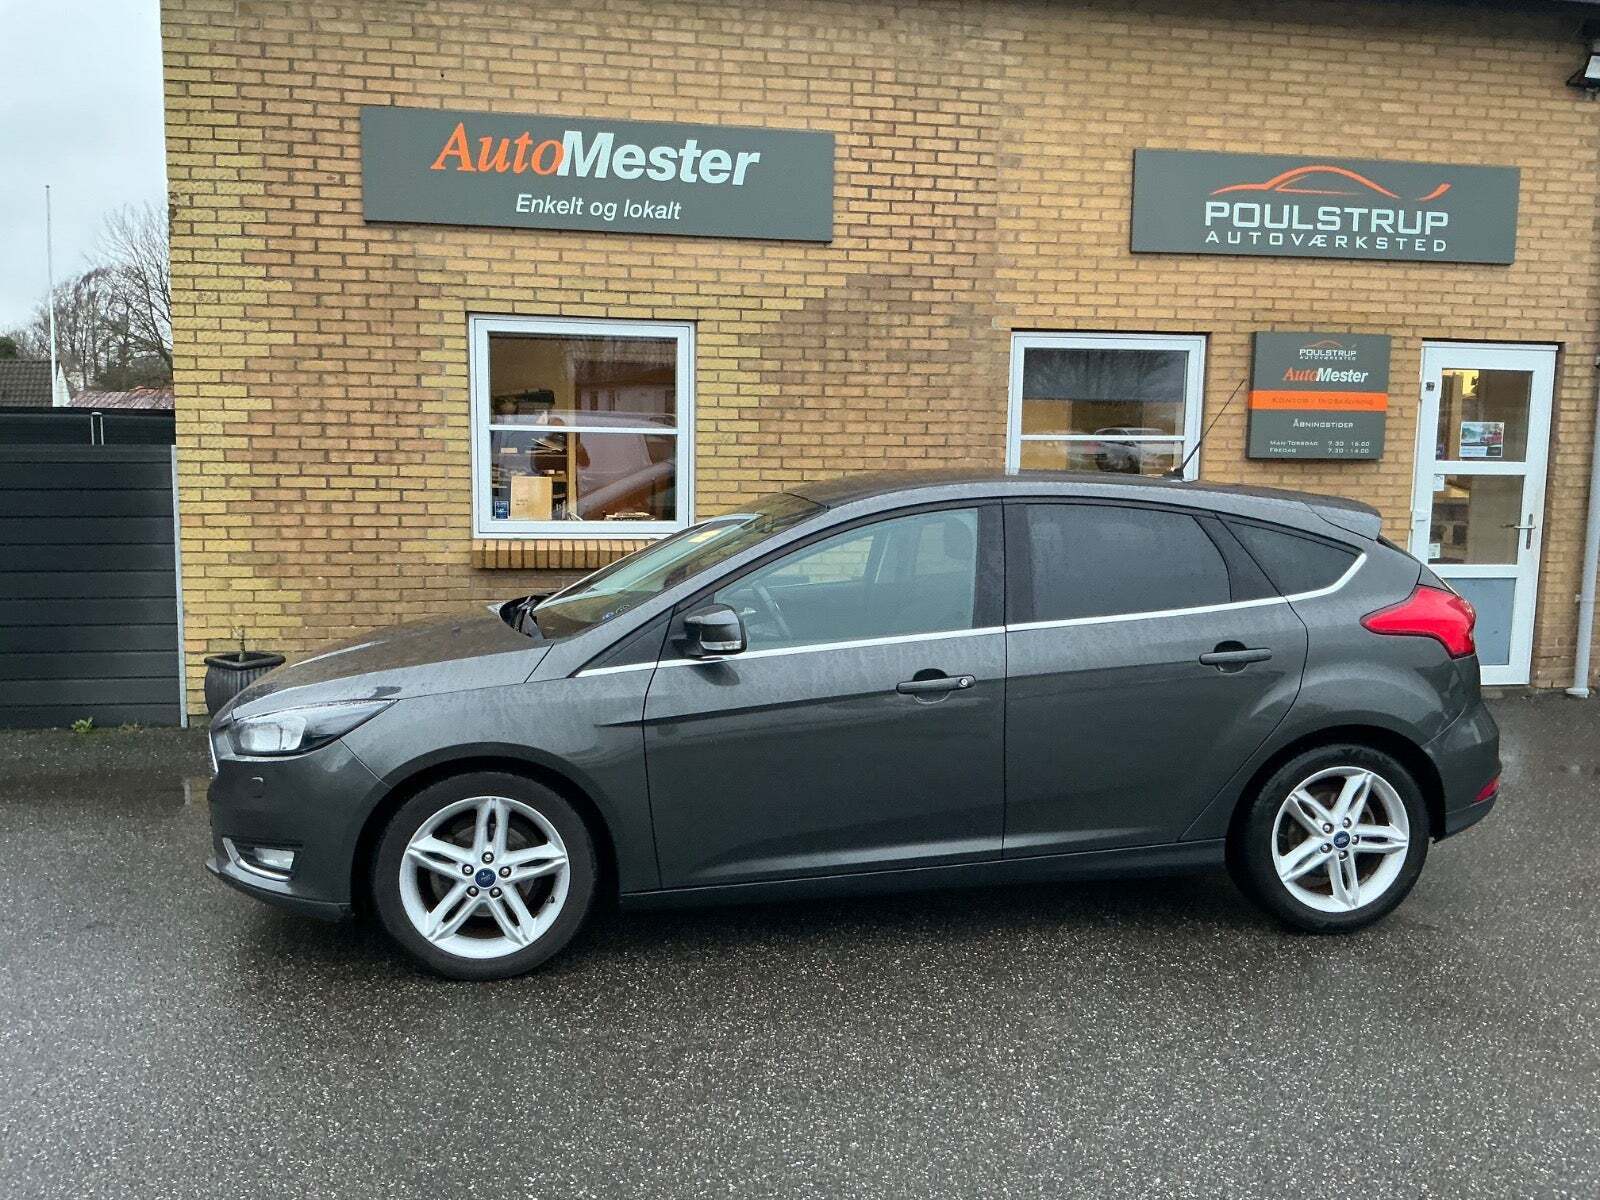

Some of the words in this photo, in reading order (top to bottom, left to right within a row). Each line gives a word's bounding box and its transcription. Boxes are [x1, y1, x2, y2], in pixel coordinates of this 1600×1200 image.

[430, 121, 760, 187] AutoMester
[515, 193, 584, 216] Enkelt
[589, 200, 617, 222] og
[623, 199, 682, 221] lokalt
[1205, 201, 1449, 235] POULSTRUP
[1205, 230, 1447, 252] AUTOVÆRKSTED
[1299, 349, 1357, 357] POULSTRUP
[1283, 367, 1369, 383] AutoMester
[1293, 418, 1354, 429] ÅBNINGSTIDER
